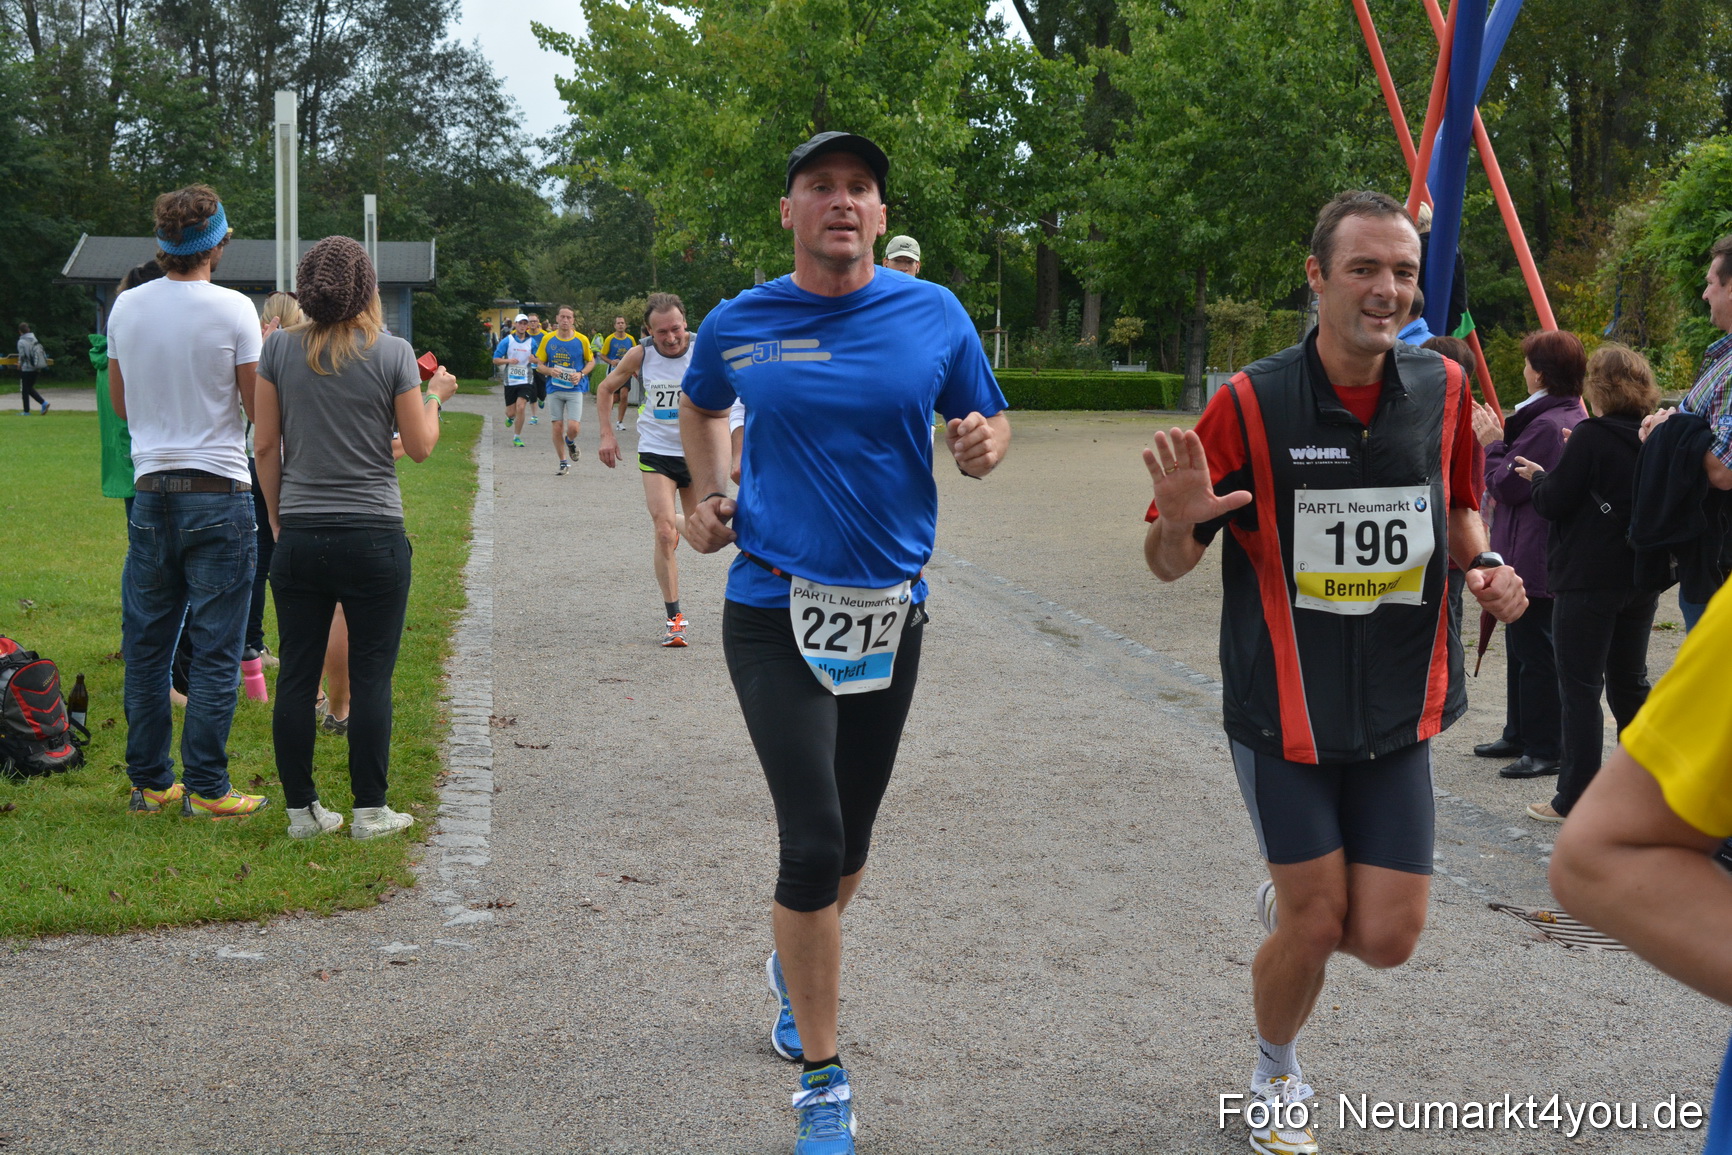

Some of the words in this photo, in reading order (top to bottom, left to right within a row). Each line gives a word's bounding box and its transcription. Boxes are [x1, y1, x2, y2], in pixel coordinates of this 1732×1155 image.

[1288, 445, 1351, 460] WÖHRL
[152, 479, 192, 491] PMA
[1298, 502, 1344, 514] PARTL
[1348, 501, 1411, 513] Neumarkt
[1325, 519, 1409, 566] 196
[1299, 562, 1305, 571] C
[1324, 576, 1402, 597] Bernhard
[793, 587, 837, 604] PARTL
[840, 595, 896, 608] Neumarkt
[801, 606, 898, 654] 2212
